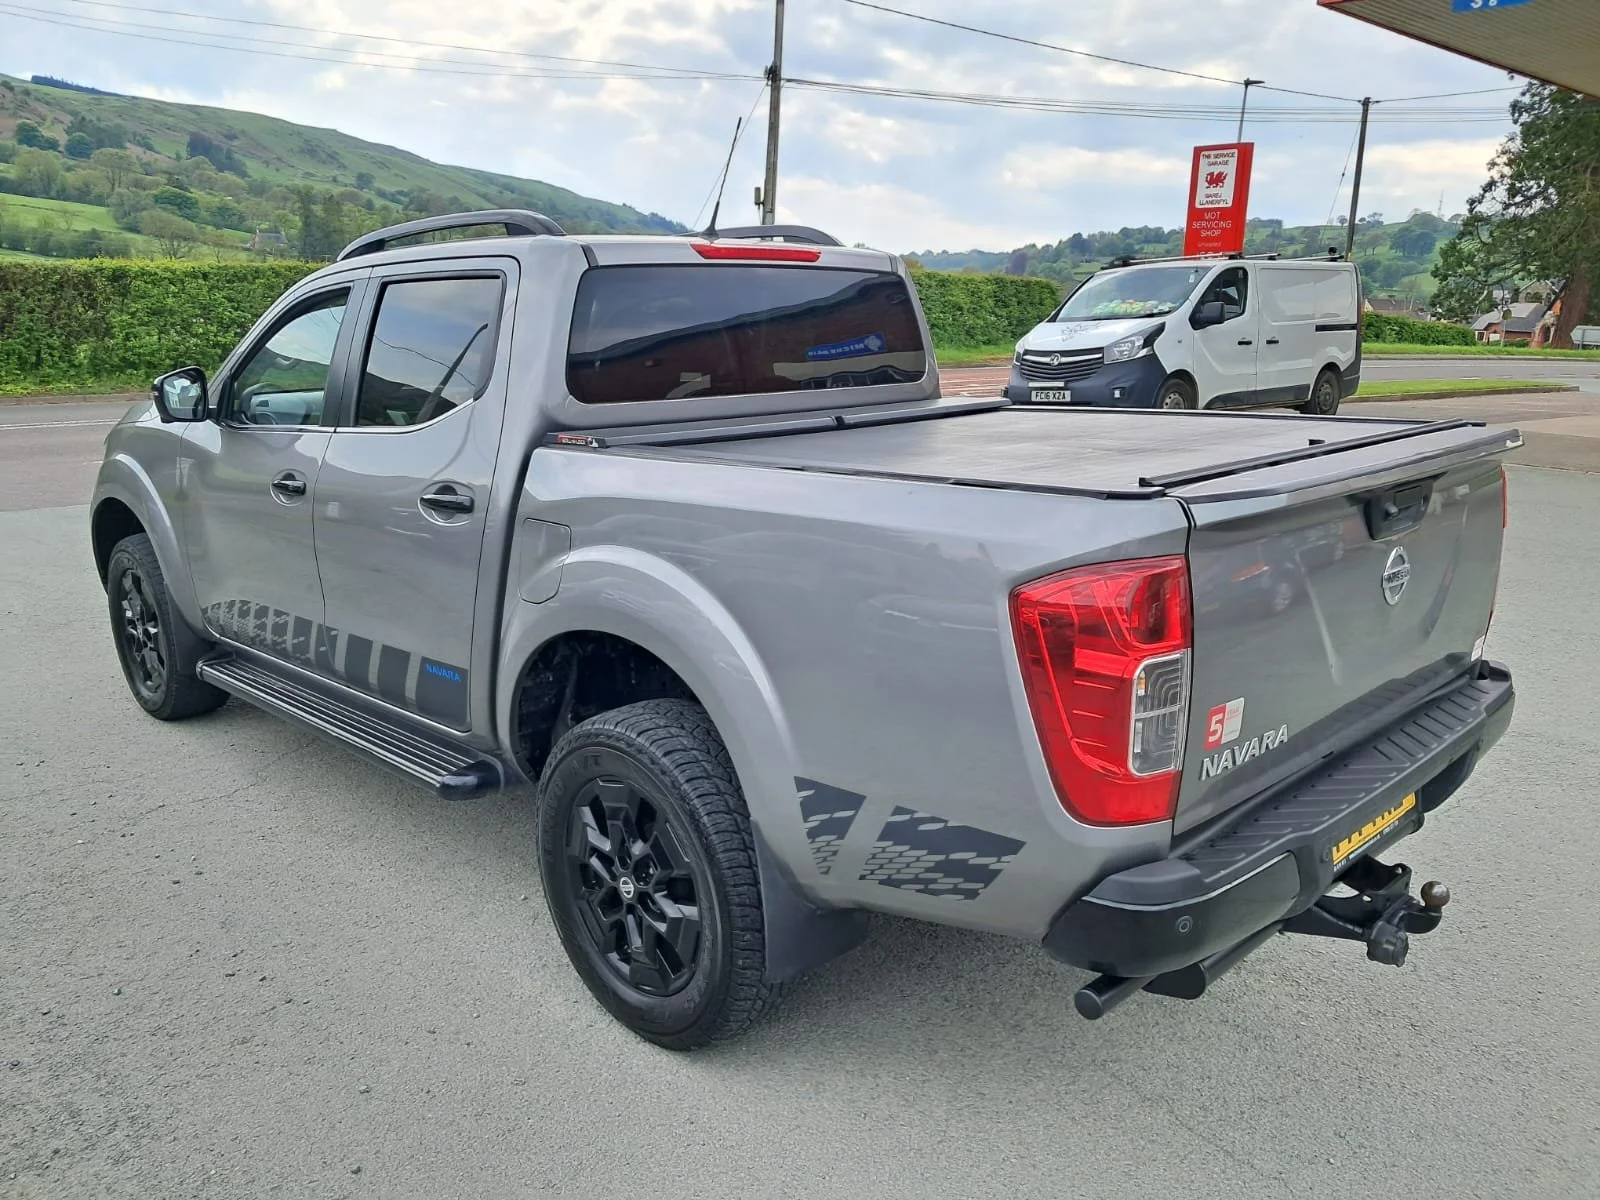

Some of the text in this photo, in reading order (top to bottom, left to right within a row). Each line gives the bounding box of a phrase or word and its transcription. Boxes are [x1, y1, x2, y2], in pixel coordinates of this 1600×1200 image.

[1204, 212, 1221, 220] MOT
[1192, 220, 1232, 229] SERVICING
[1200, 229, 1222, 237] SHOP
[1052, 391, 1066, 400] XZA
[1208, 712, 1224, 743] 5
[1201, 723, 1289, 781] NAVARA
